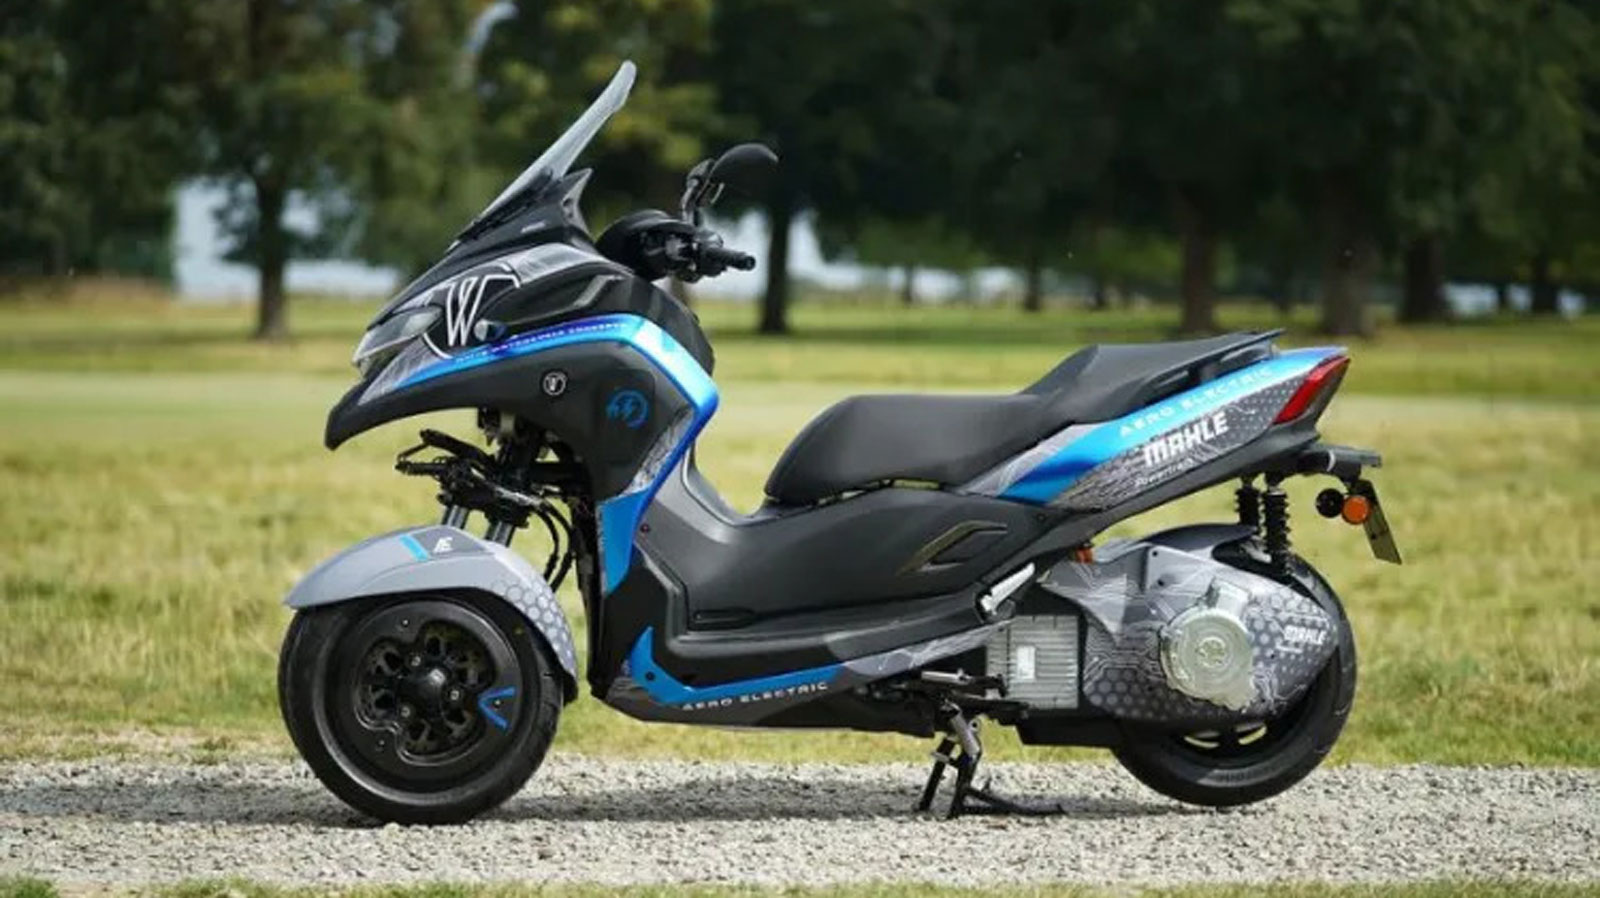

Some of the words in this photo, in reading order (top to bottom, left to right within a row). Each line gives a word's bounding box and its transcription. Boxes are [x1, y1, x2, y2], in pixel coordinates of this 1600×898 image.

[1120, 406, 1174, 437] AERO
[1144, 410, 1230, 467] MAHLE
[682, 697, 733, 712] AERO
[739, 681, 829, 704] ELECTRIC
